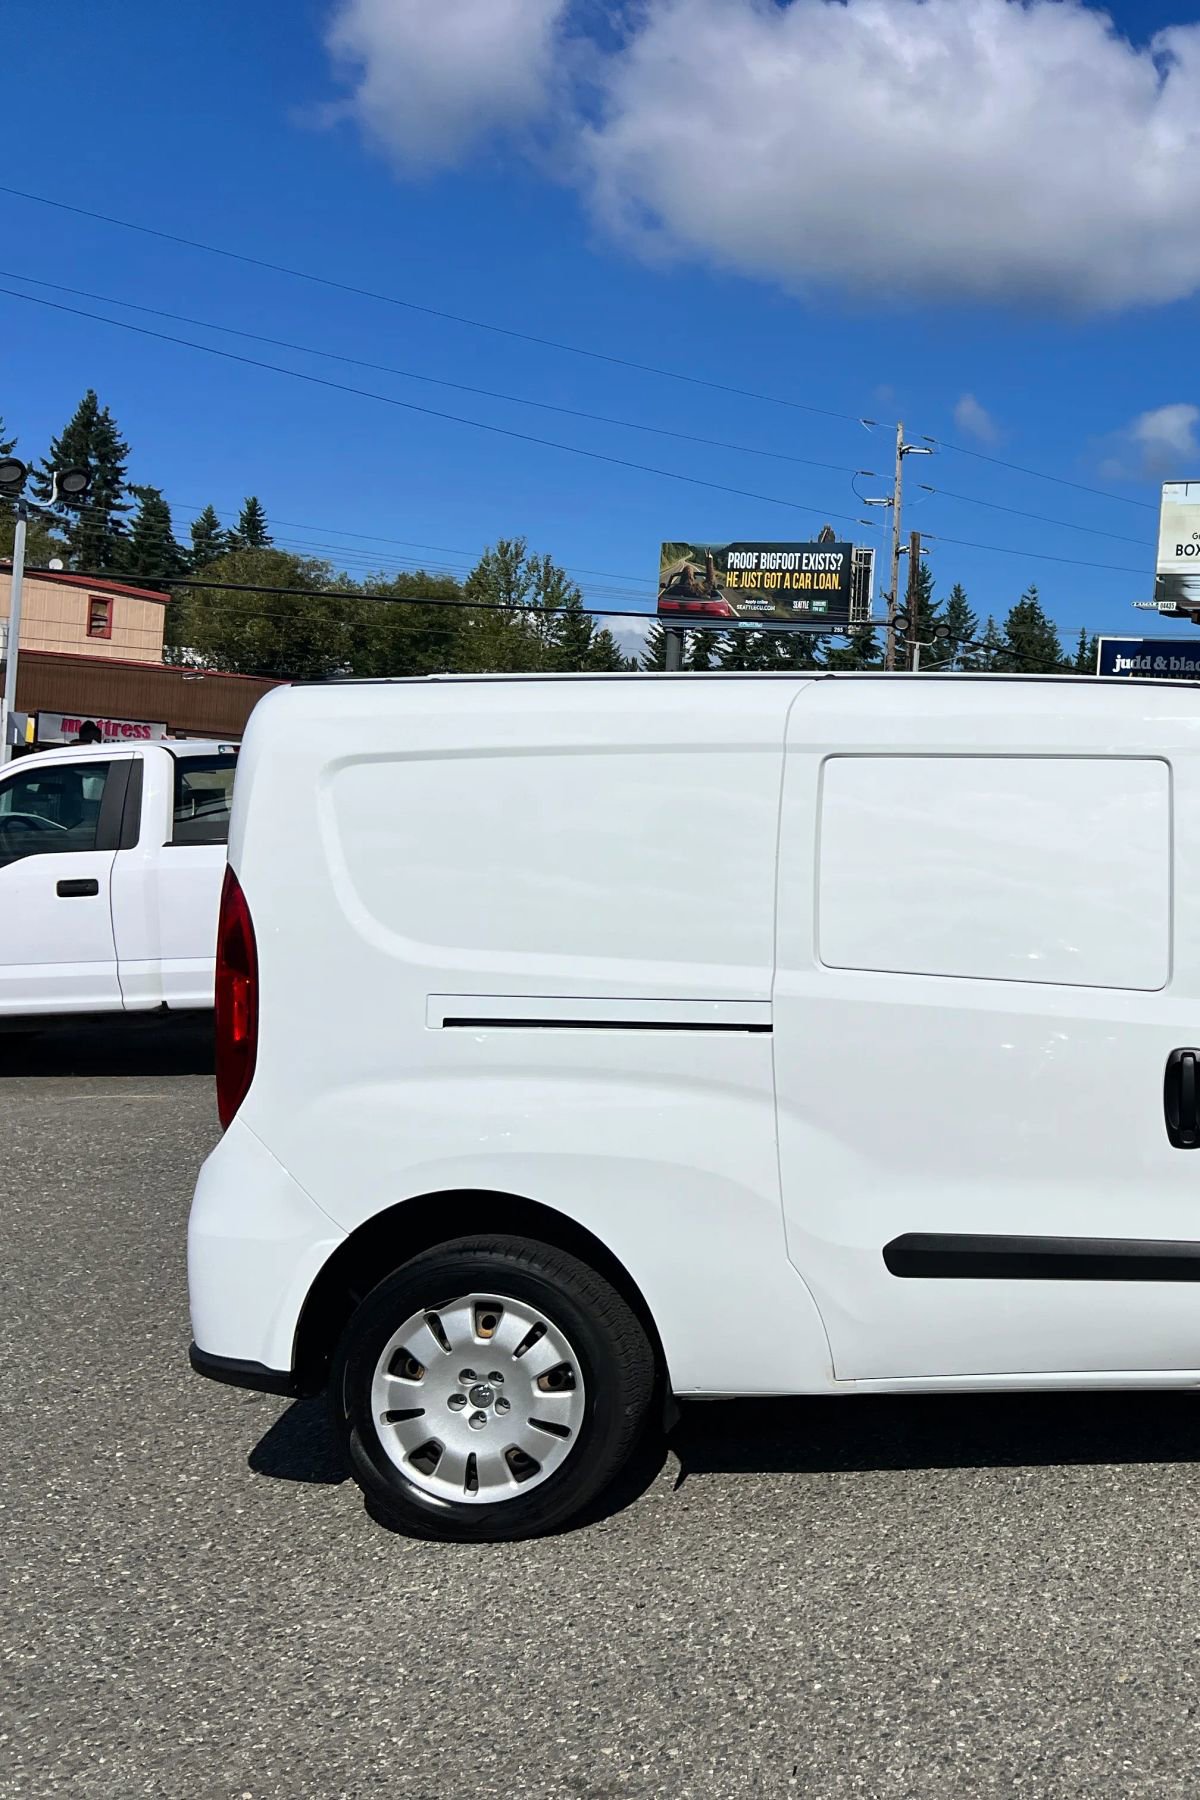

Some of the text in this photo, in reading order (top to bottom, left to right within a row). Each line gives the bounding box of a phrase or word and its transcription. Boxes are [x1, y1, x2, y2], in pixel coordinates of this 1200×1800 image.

[727, 552, 844, 571] PROOF BIGFOOT EXISTS?
[726, 571, 842, 590] HE JUST GOT A CAR LOAN.
[792, 600, 810, 609] SEATTLE
[1112, 654, 1151, 673] judd
[1153, 656, 1168, 671] &
[61, 718, 152, 739] mttress
